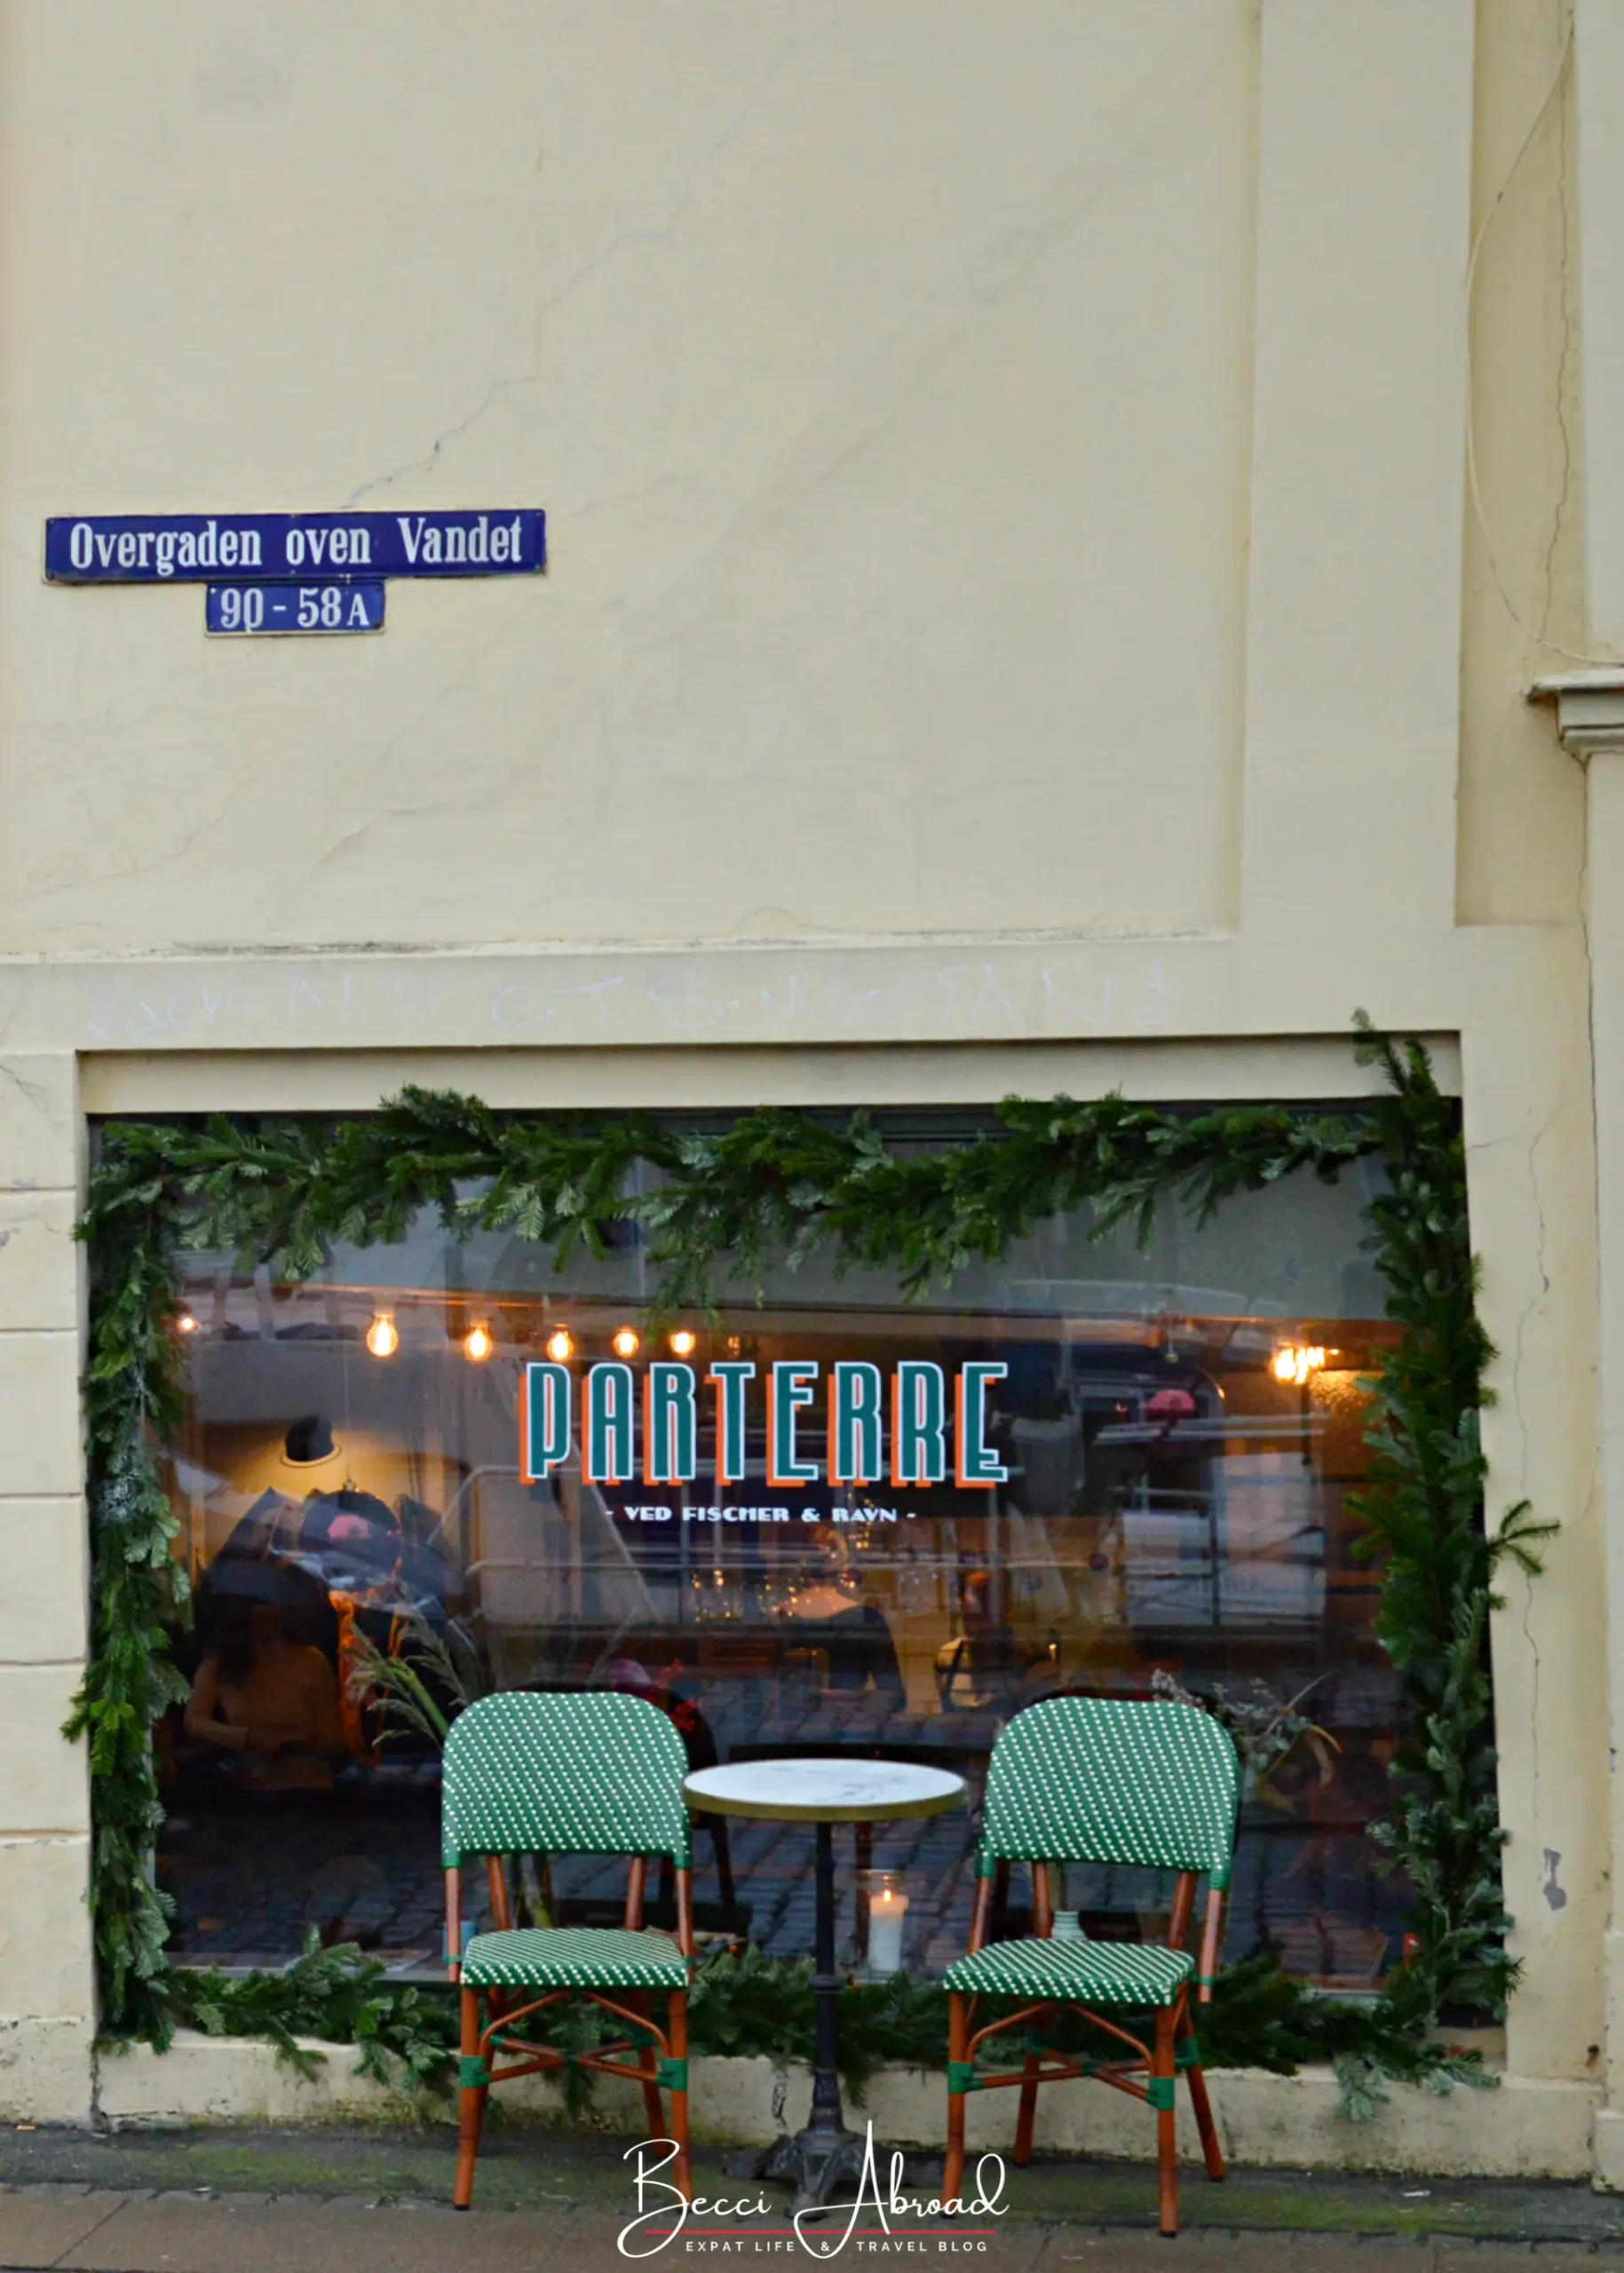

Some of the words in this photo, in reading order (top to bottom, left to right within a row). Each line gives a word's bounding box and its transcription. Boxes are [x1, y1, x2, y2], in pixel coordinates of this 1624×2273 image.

[68, 521, 262, 575] Overgaden
[285, 525, 371, 565] oven
[397, 516, 523, 564] Vandet
[220, 588, 265, 629] 90
[519, 1361, 1009, 1488] PARTERRE
[624, 1507, 673, 1522] VED
[682, 1507, 789, 1523] FISCHER
[802, 1507, 821, 1523] &
[831, 1508, 898, 1523] RAVN
